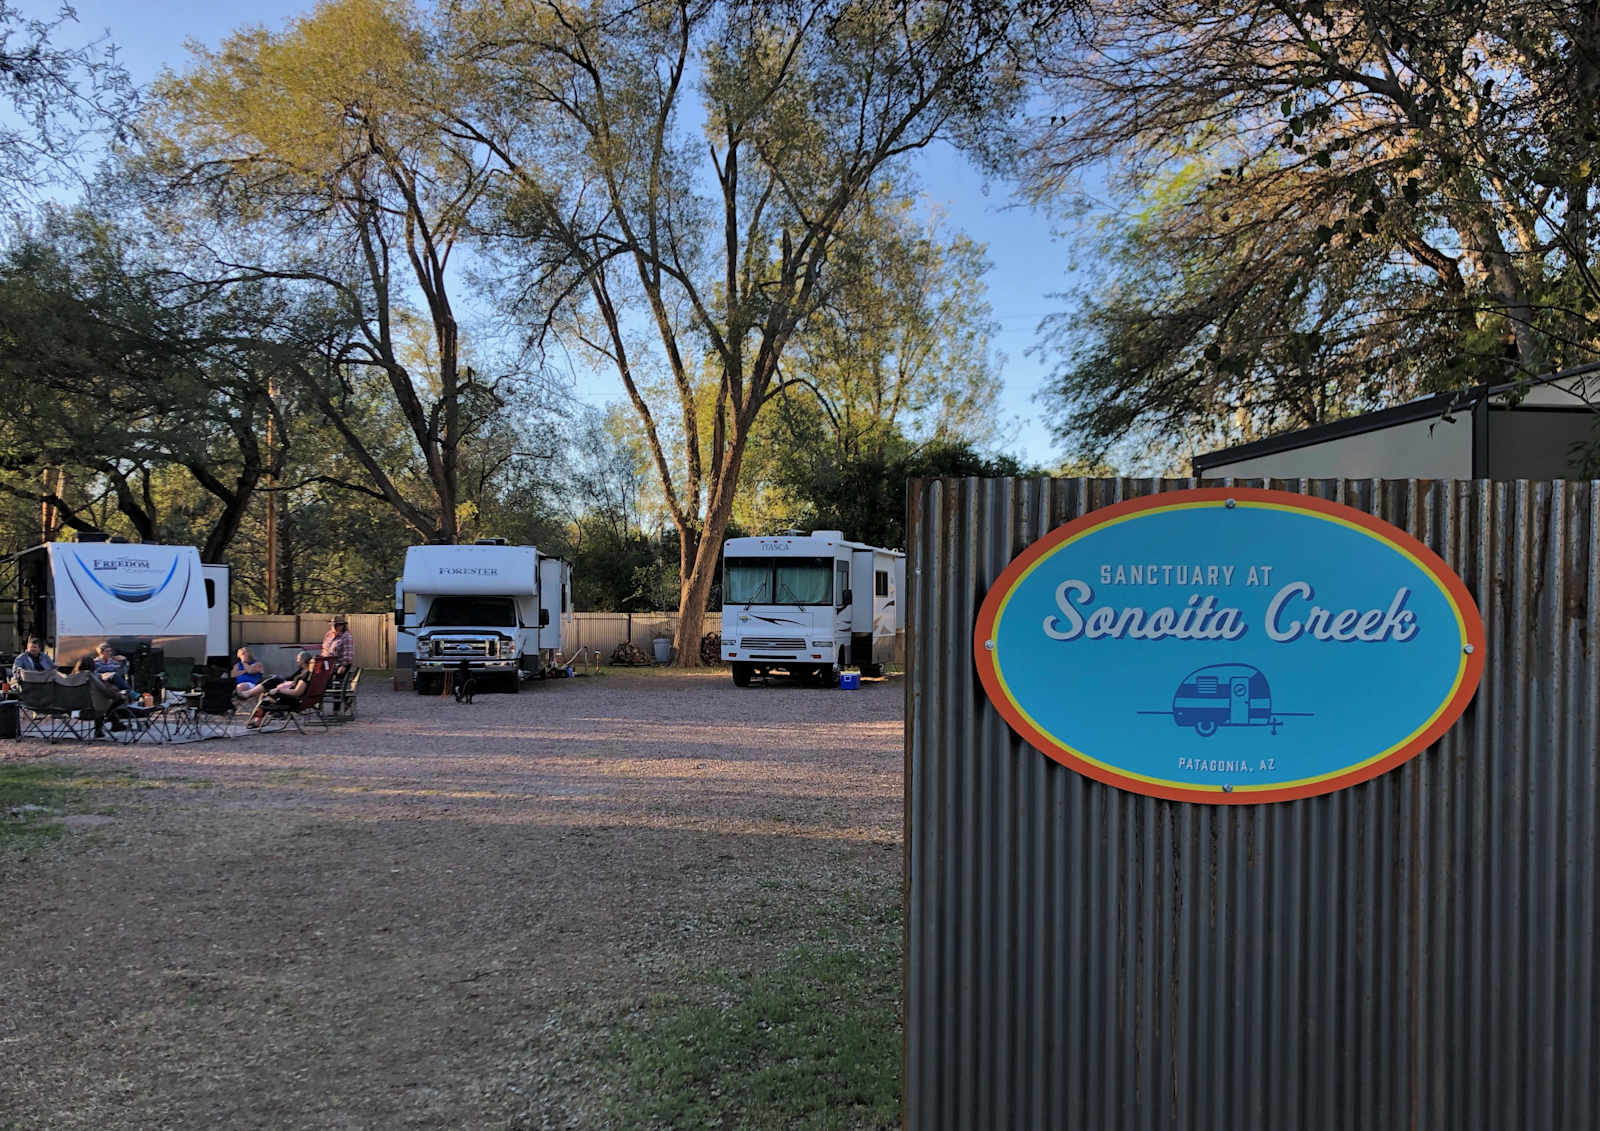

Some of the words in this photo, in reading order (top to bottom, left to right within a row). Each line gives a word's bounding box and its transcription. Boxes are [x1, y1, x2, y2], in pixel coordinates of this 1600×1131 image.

[93, 559, 150, 569] FREEDOM
[439, 567, 499, 577] FORESTER
[1100, 564, 1236, 586] SANCTUARY
[1246, 565, 1273, 587] AT
[1042, 579, 1248, 641] Sonoita
[1264, 581, 1420, 643] Creek
[1178, 757, 1254, 773] PATAGONIA,
[1259, 758, 1277, 772] AZ
